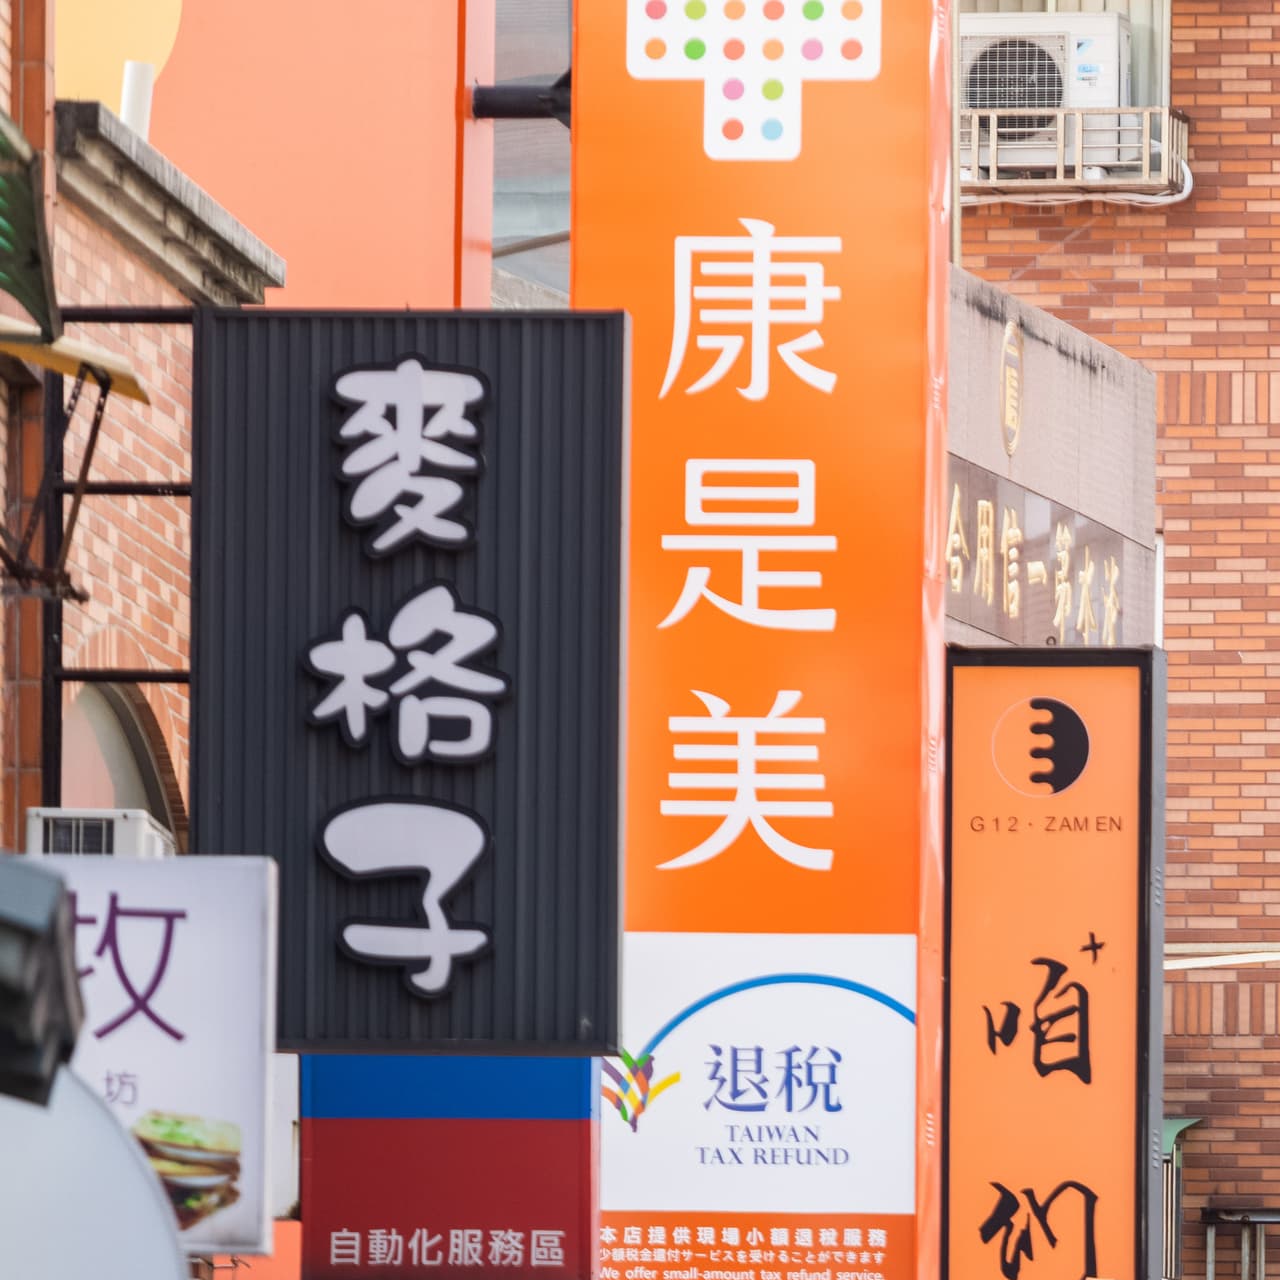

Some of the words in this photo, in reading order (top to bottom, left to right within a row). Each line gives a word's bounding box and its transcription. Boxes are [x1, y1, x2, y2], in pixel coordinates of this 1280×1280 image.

[657, 217, 843, 871] 康是美
[308, 358, 507, 993] 麥格子
[104, 1069, 139, 1104] 坊
[703, 1043, 843, 1113] 退稅
[725, 1124, 821, 1143] TAIWAN
[696, 1146, 744, 1165] TAX
[752, 1147, 850, 1166] REFUND
[328, 1228, 567, 1267] 自動化服務區
[600, 1226, 887, 1248] 本店提供現場小額退稅服務
[625, 1266, 658, 1280] offer
